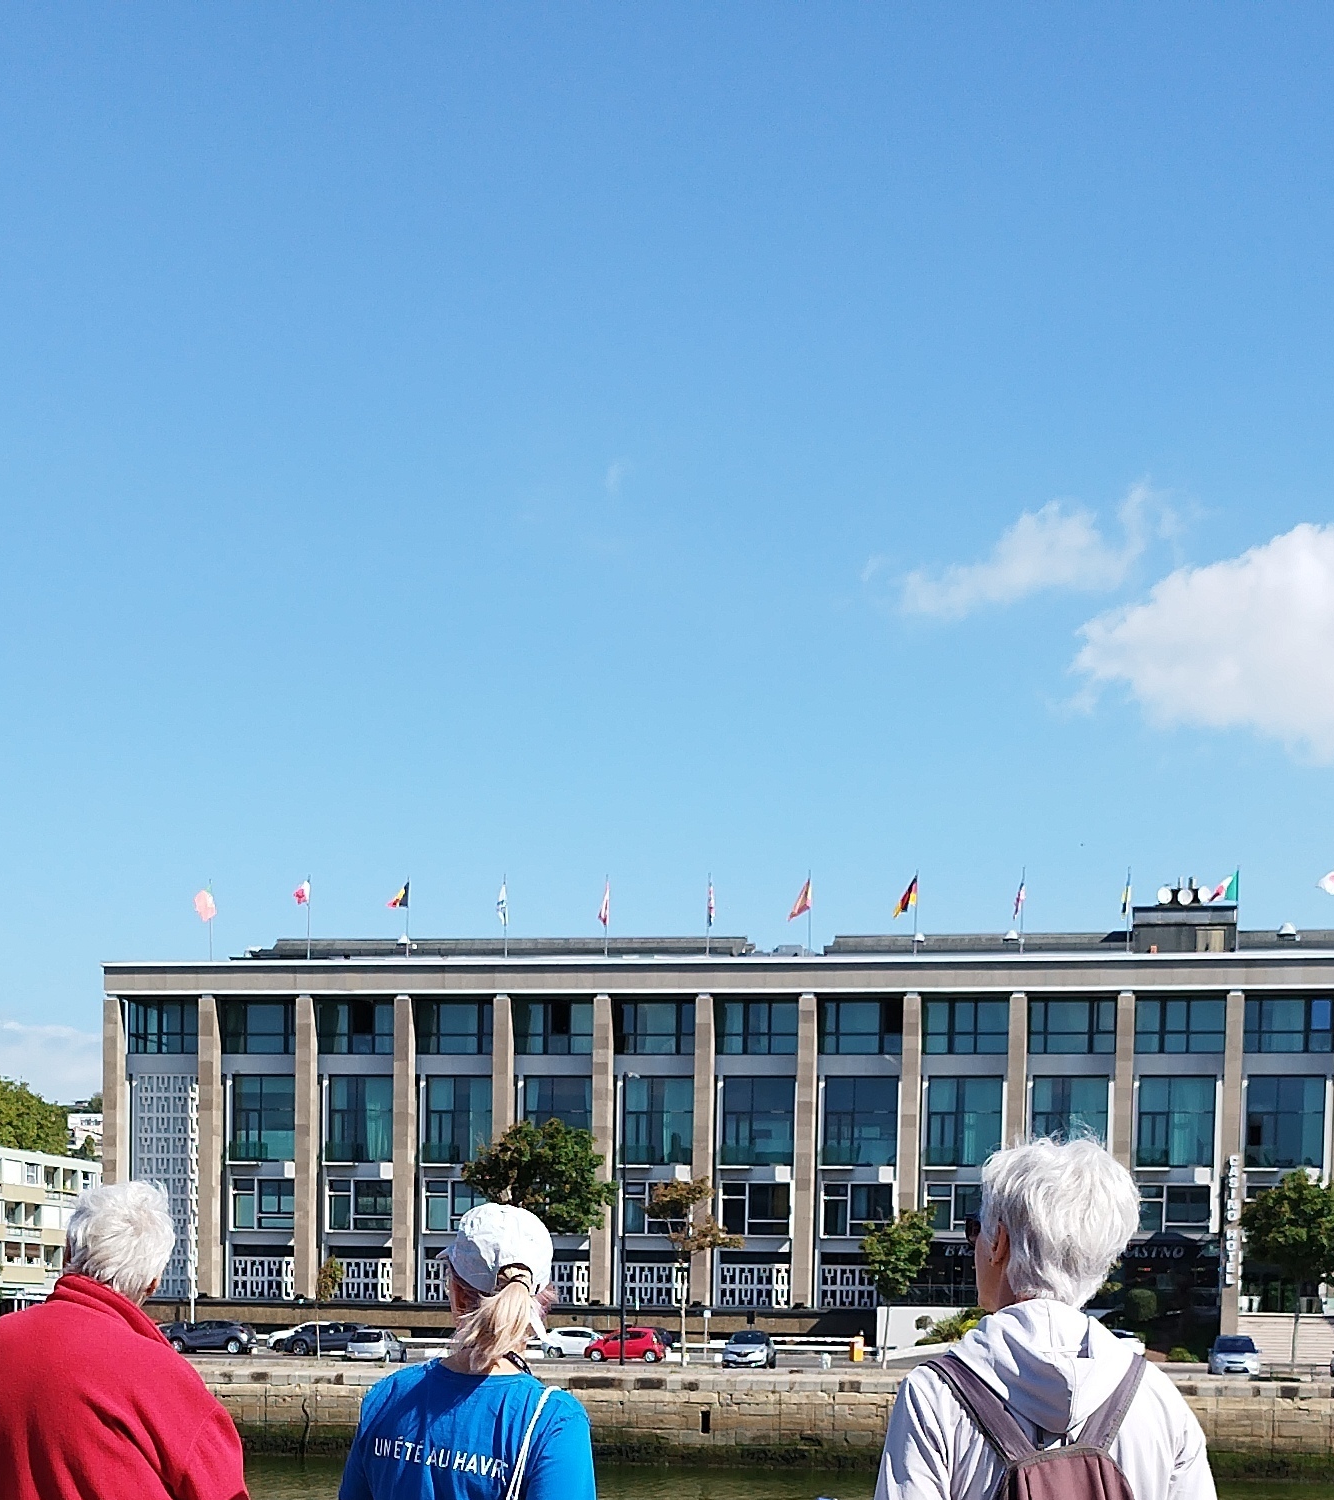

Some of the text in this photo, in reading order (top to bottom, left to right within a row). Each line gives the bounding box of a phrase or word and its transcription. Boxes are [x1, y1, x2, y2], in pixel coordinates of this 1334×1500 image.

[374, 1437, 392, 1457] UN
[393, 1435, 424, 1463] ÉTÉ
[425, 1446, 451, 1468] AU
